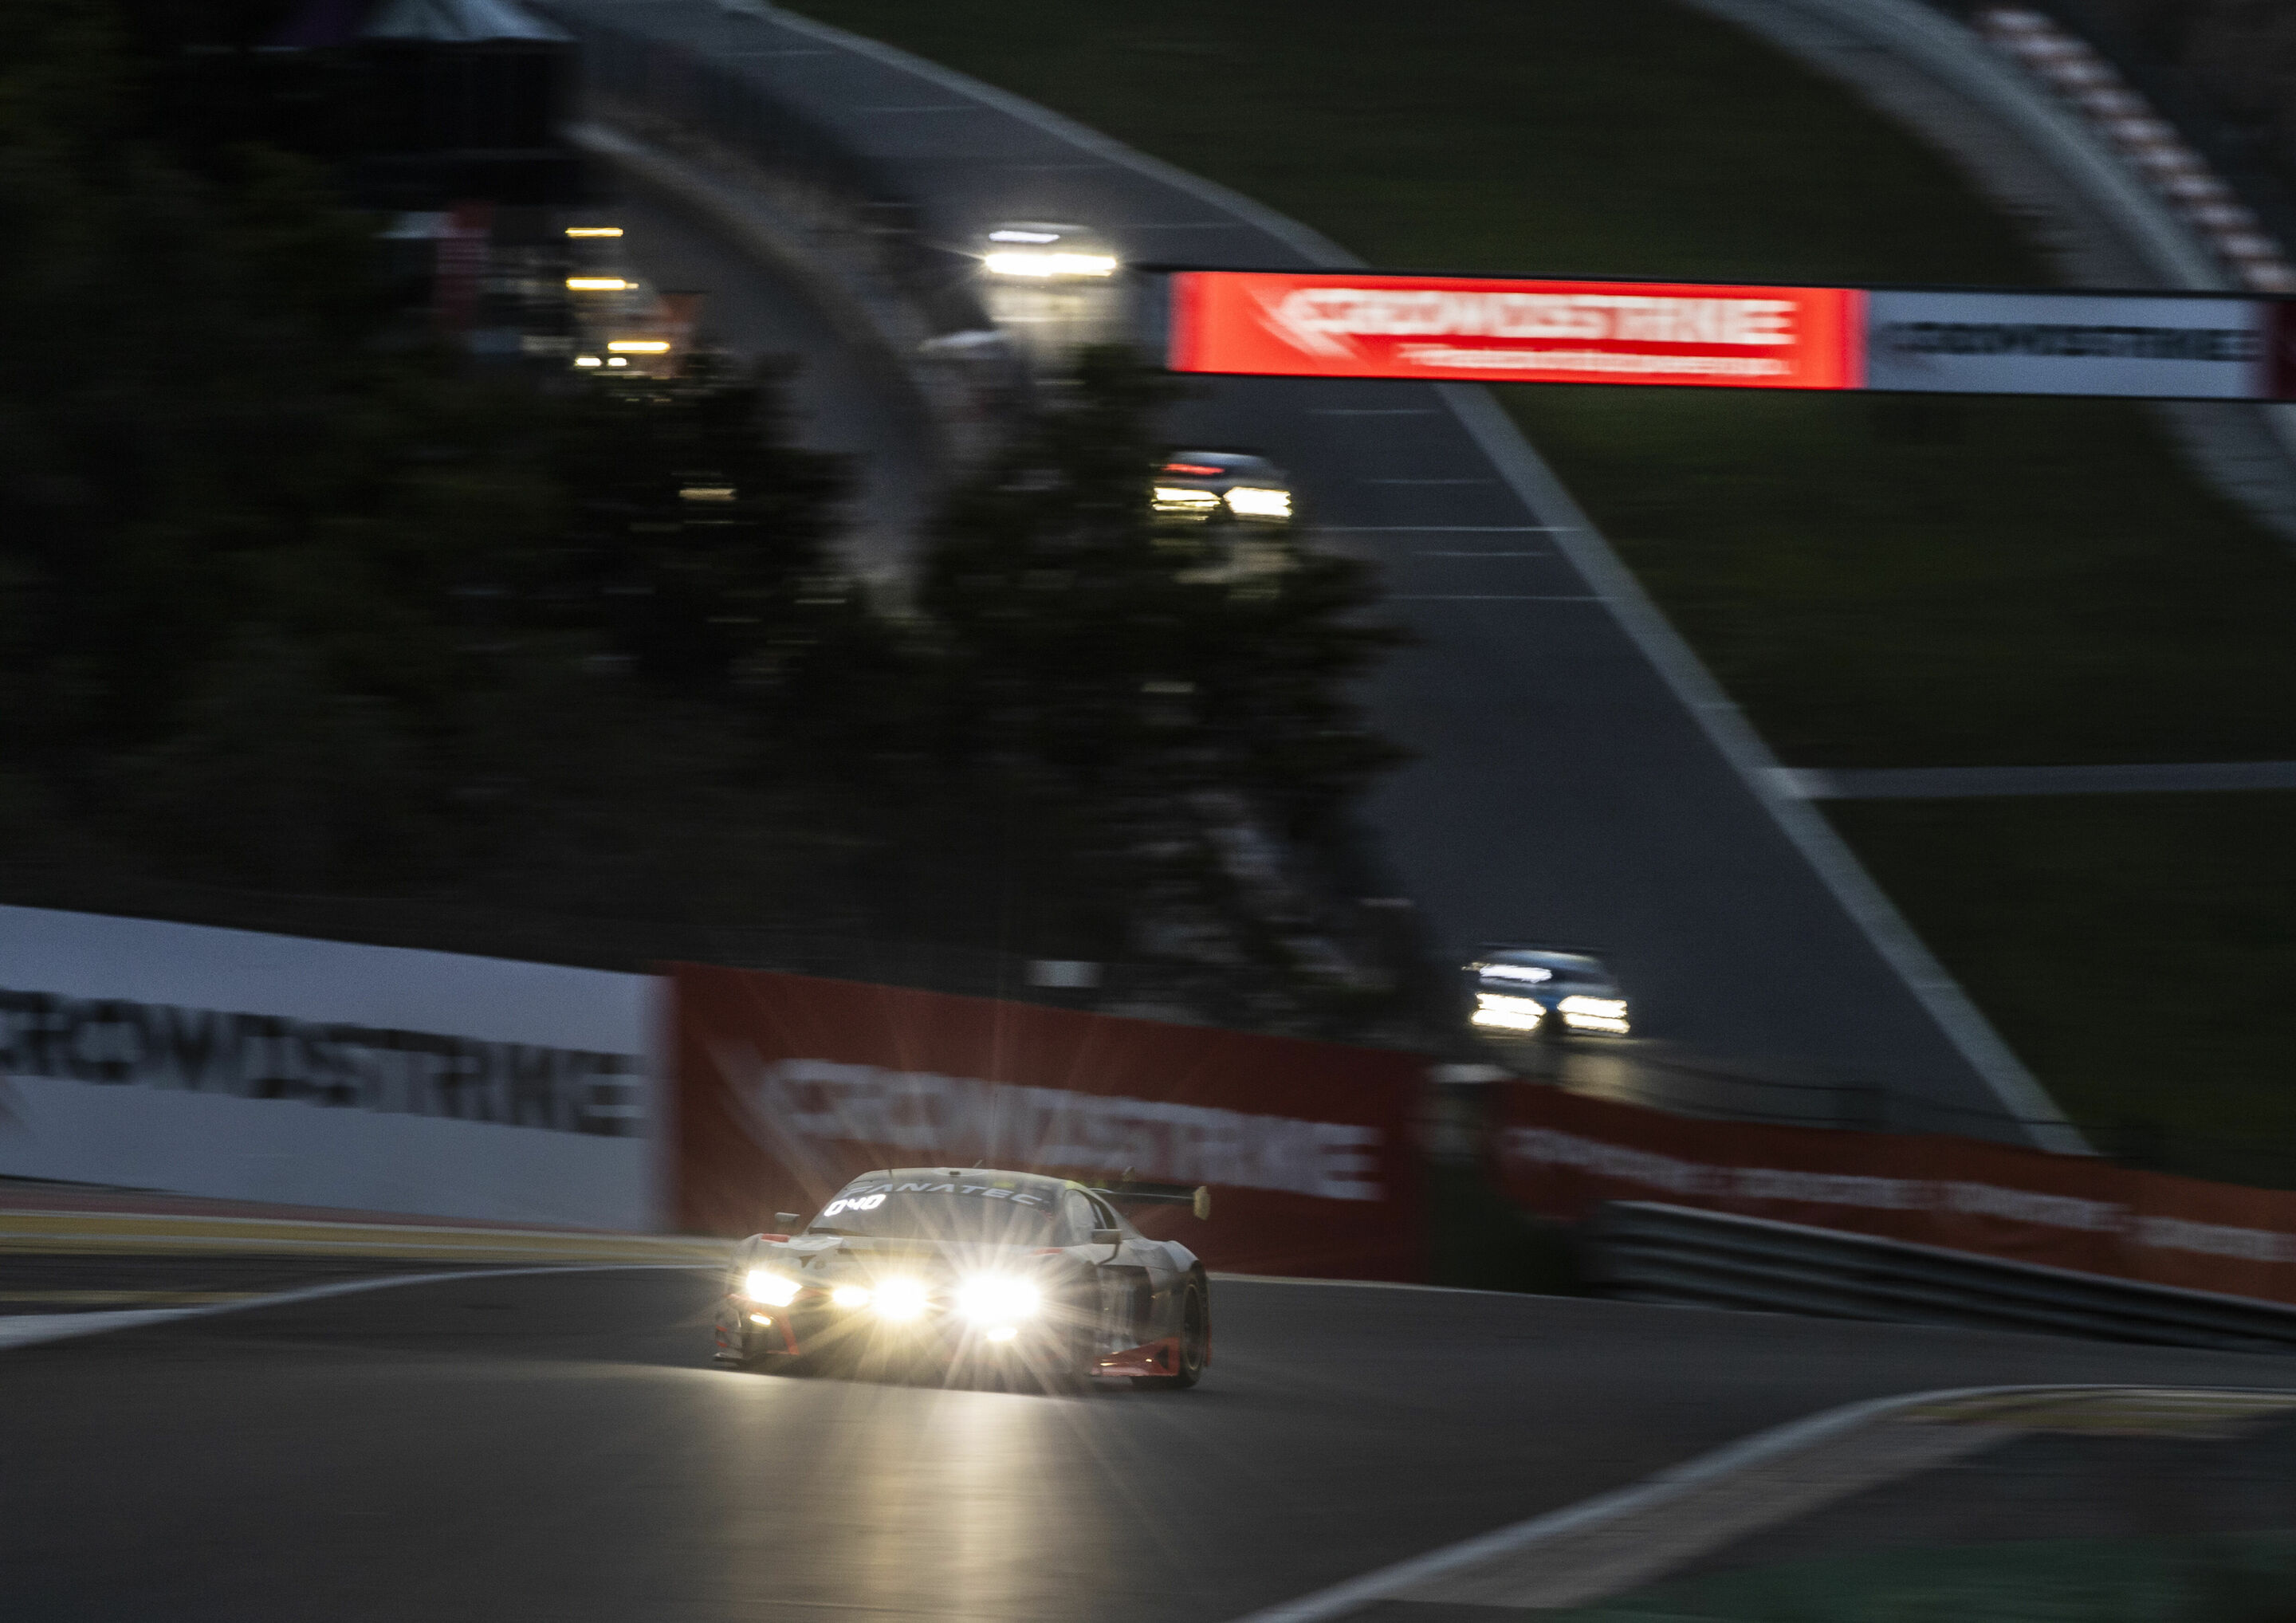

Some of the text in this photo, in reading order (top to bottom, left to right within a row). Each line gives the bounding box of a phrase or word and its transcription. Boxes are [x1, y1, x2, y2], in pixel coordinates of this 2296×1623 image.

[0, 990, 647, 1138] ROWDSTRIKE
[824, 1194, 887, 1216] 040
[842, 1183, 1044, 1205] FANATEC
